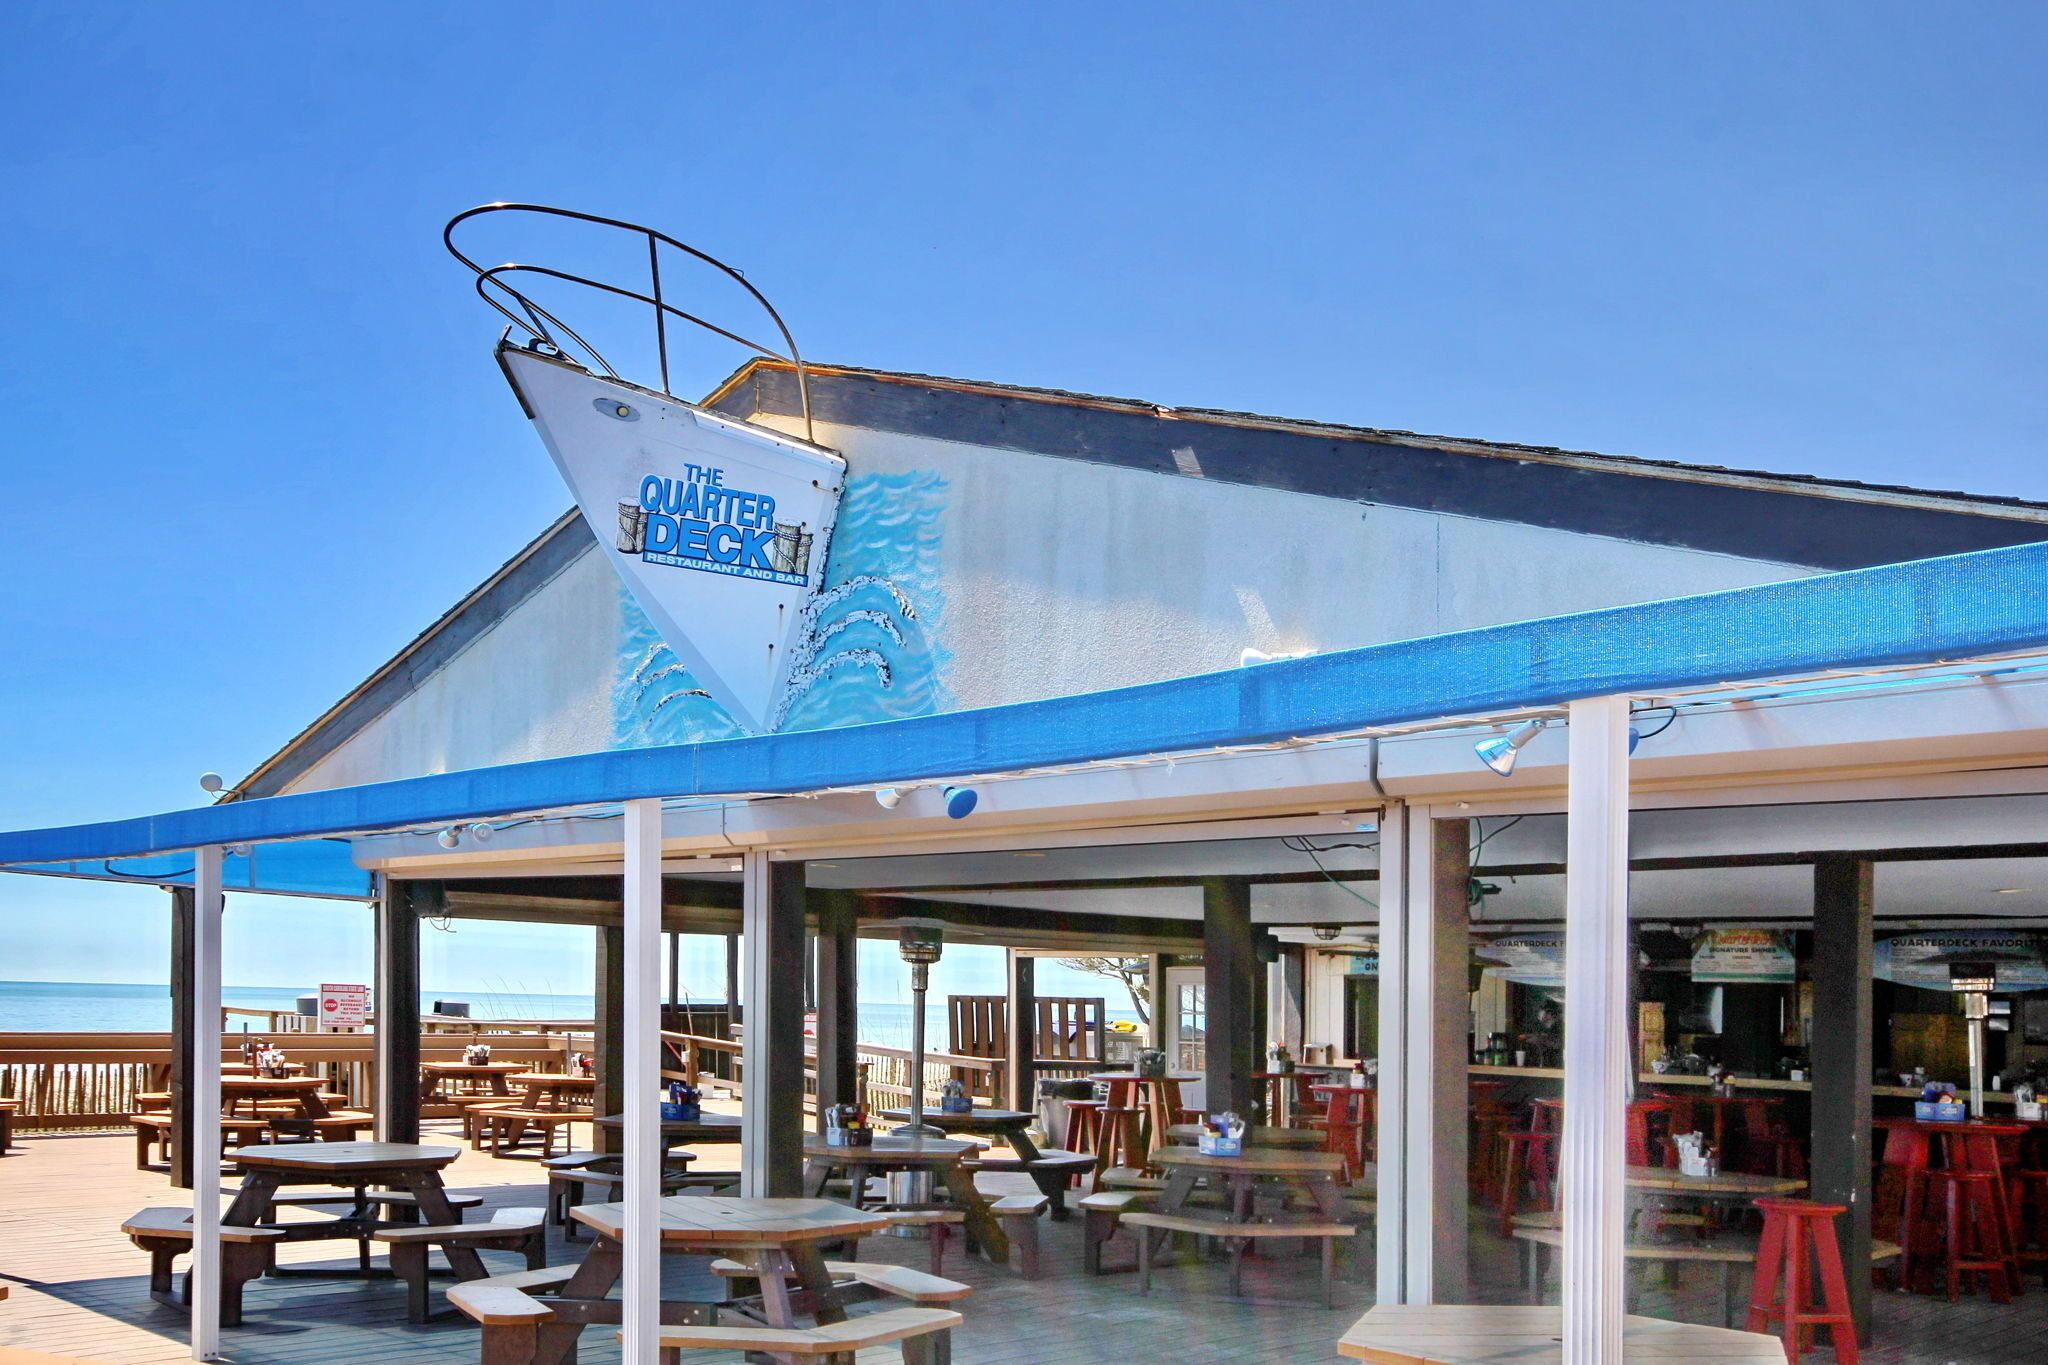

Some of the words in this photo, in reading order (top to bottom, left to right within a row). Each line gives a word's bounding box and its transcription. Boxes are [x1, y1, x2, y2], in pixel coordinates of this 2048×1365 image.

[683, 463, 724, 487] THE
[640, 475, 776, 530] QUARTER
[644, 512, 777, 570] DECK
[646, 552, 741, 574] RESTAURANT
[742, 568, 773, 581] AND
[775, 572, 805, 586] BAR
[1890, 939, 1979, 948] QUARTERDECK
